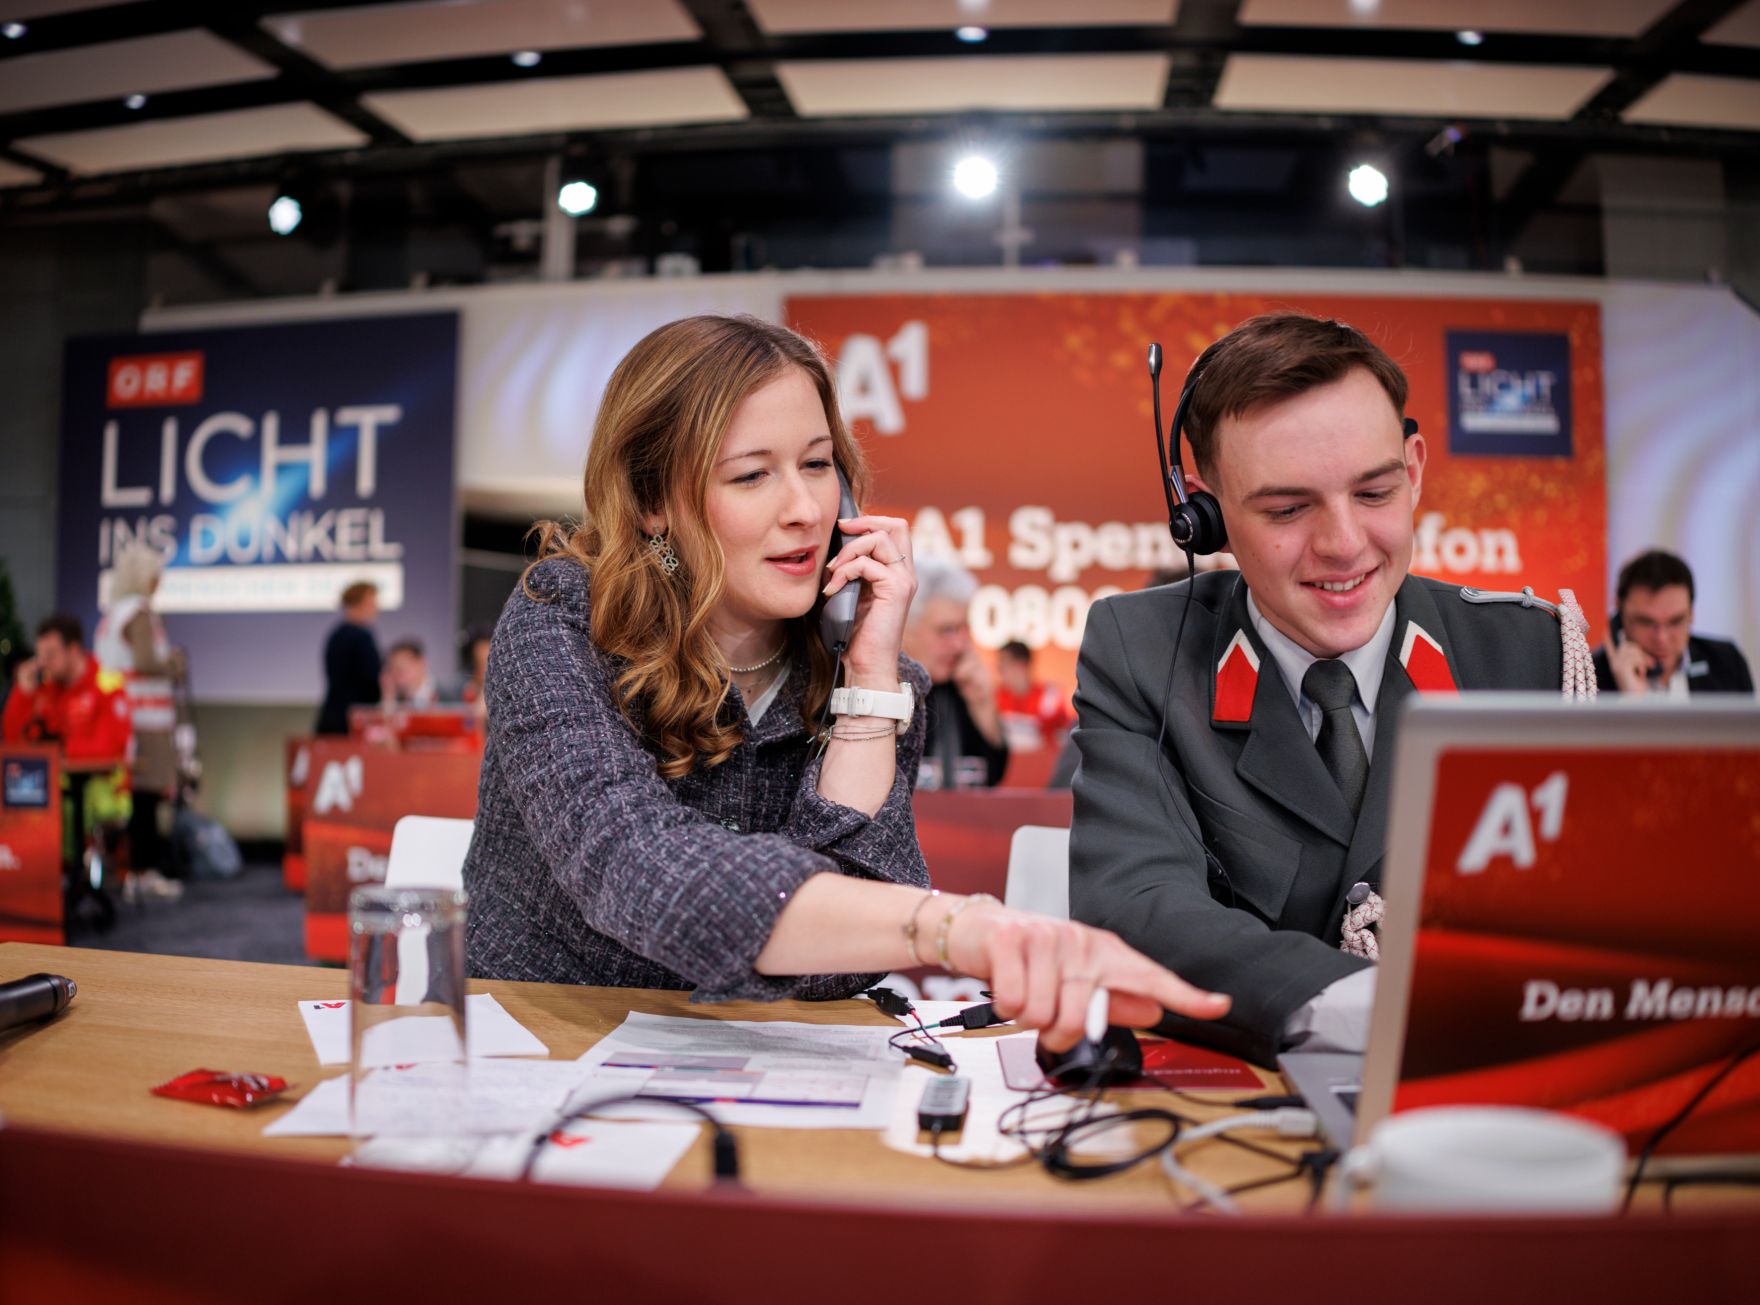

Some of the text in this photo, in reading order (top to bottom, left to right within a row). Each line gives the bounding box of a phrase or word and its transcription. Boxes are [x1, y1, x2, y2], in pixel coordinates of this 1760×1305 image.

[112, 359, 200, 399] ORF
[836, 319, 930, 437] A1
[101, 403, 403, 507] LICHT
[98, 507, 404, 567] INS DUNKEL
[909, 504, 994, 570] A1
[967, 584, 1129, 651] 080
[1456, 770, 1569, 876] A1
[1519, 978, 1615, 1021] Den
